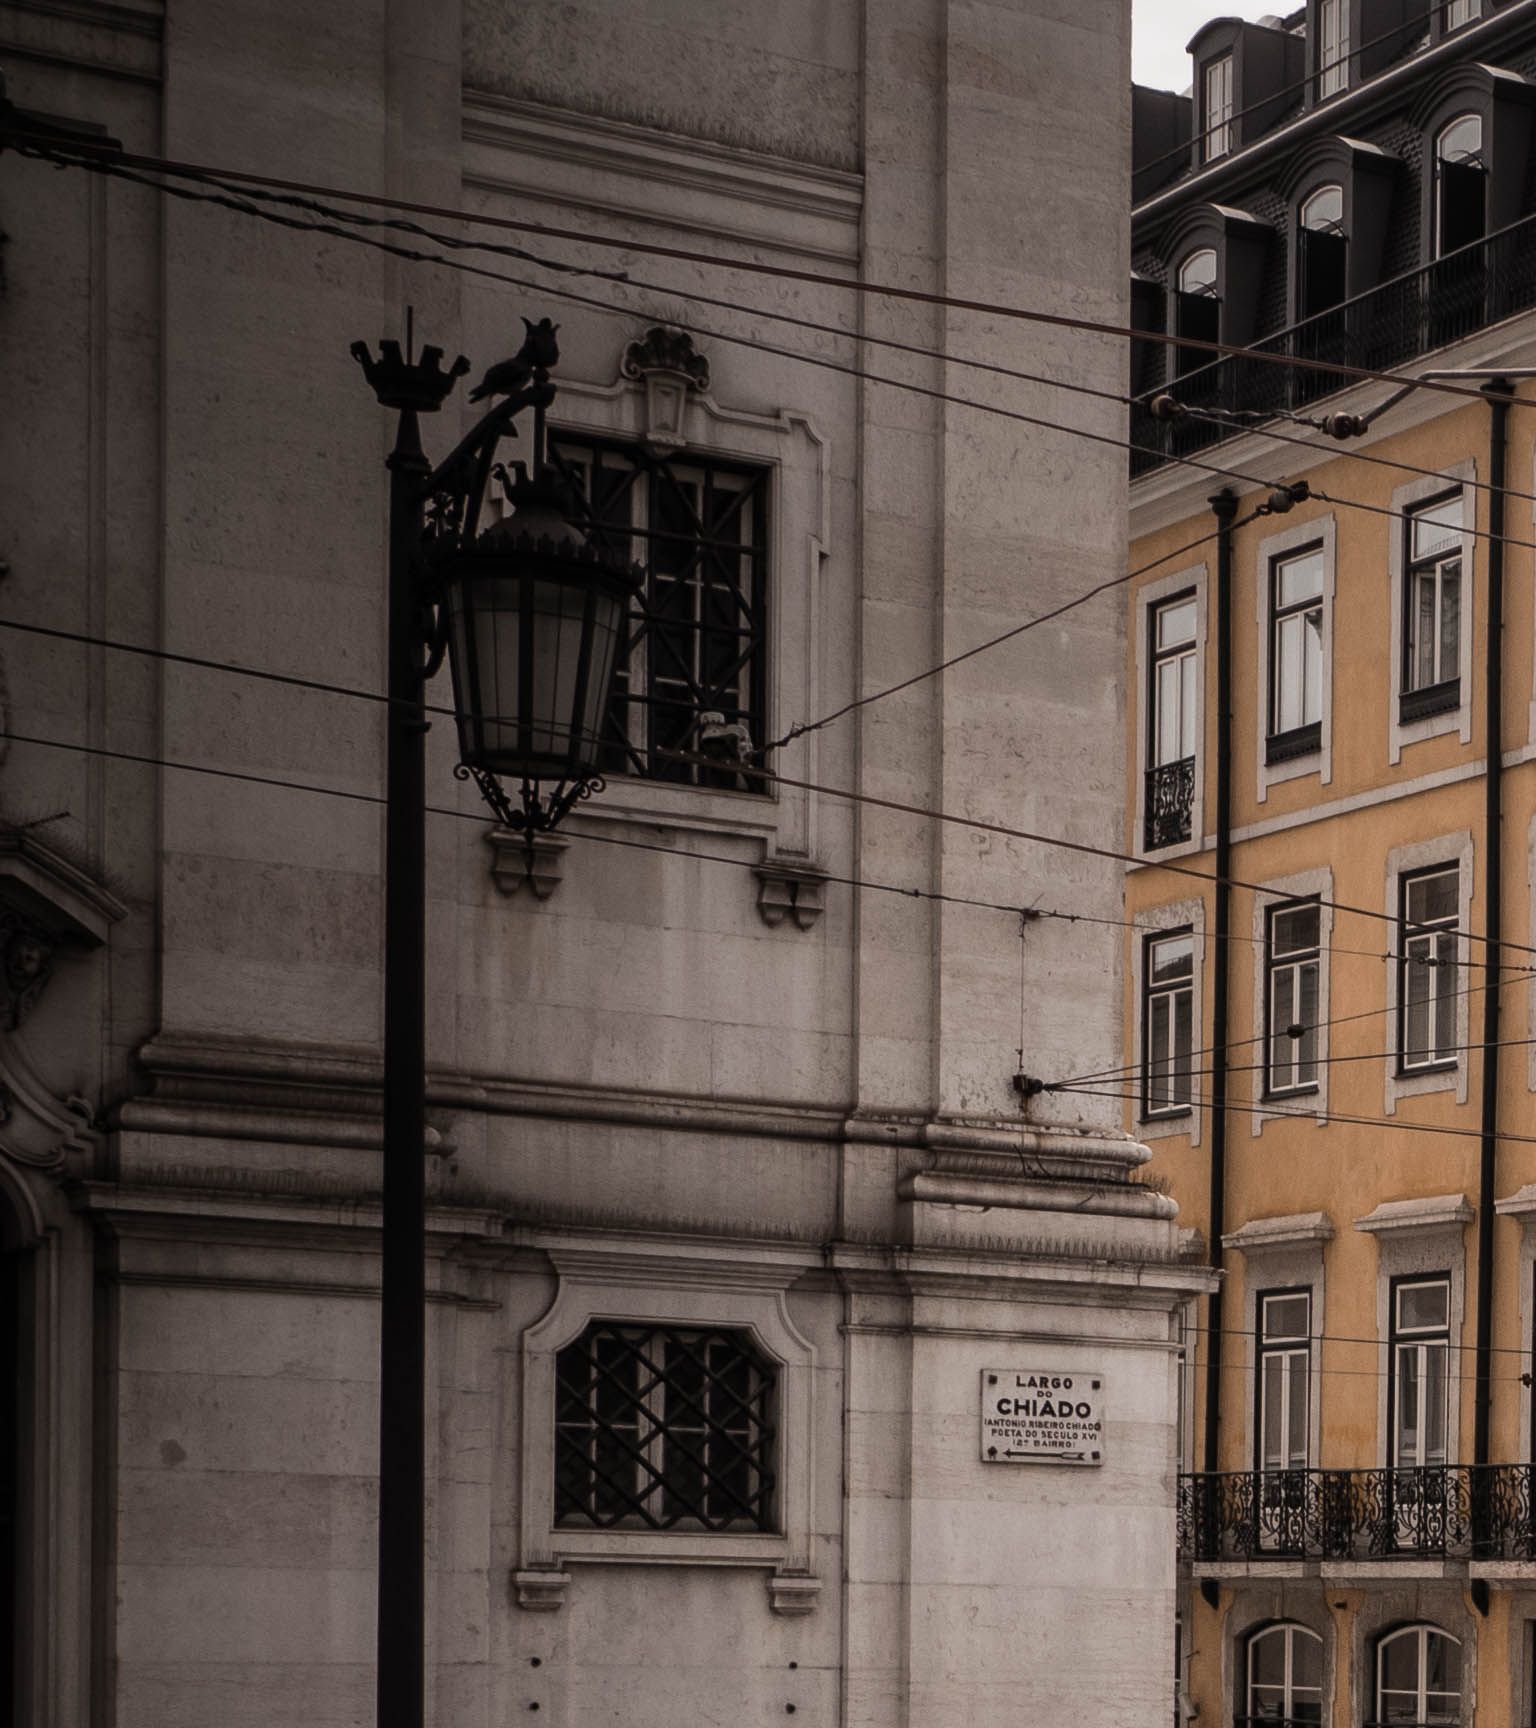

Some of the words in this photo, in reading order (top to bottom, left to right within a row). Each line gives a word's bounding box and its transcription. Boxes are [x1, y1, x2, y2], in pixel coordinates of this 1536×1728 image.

[1016, 1375, 1073, 1389] LARGO
[997, 1398, 1091, 1419] CHIADO
[1029, 1420, 1065, 1430] RIBEIRO
[991, 1428, 1023, 1438] POETA
[1025, 1430, 1038, 1438] DO
[1082, 1432, 1097, 1441] XVI
